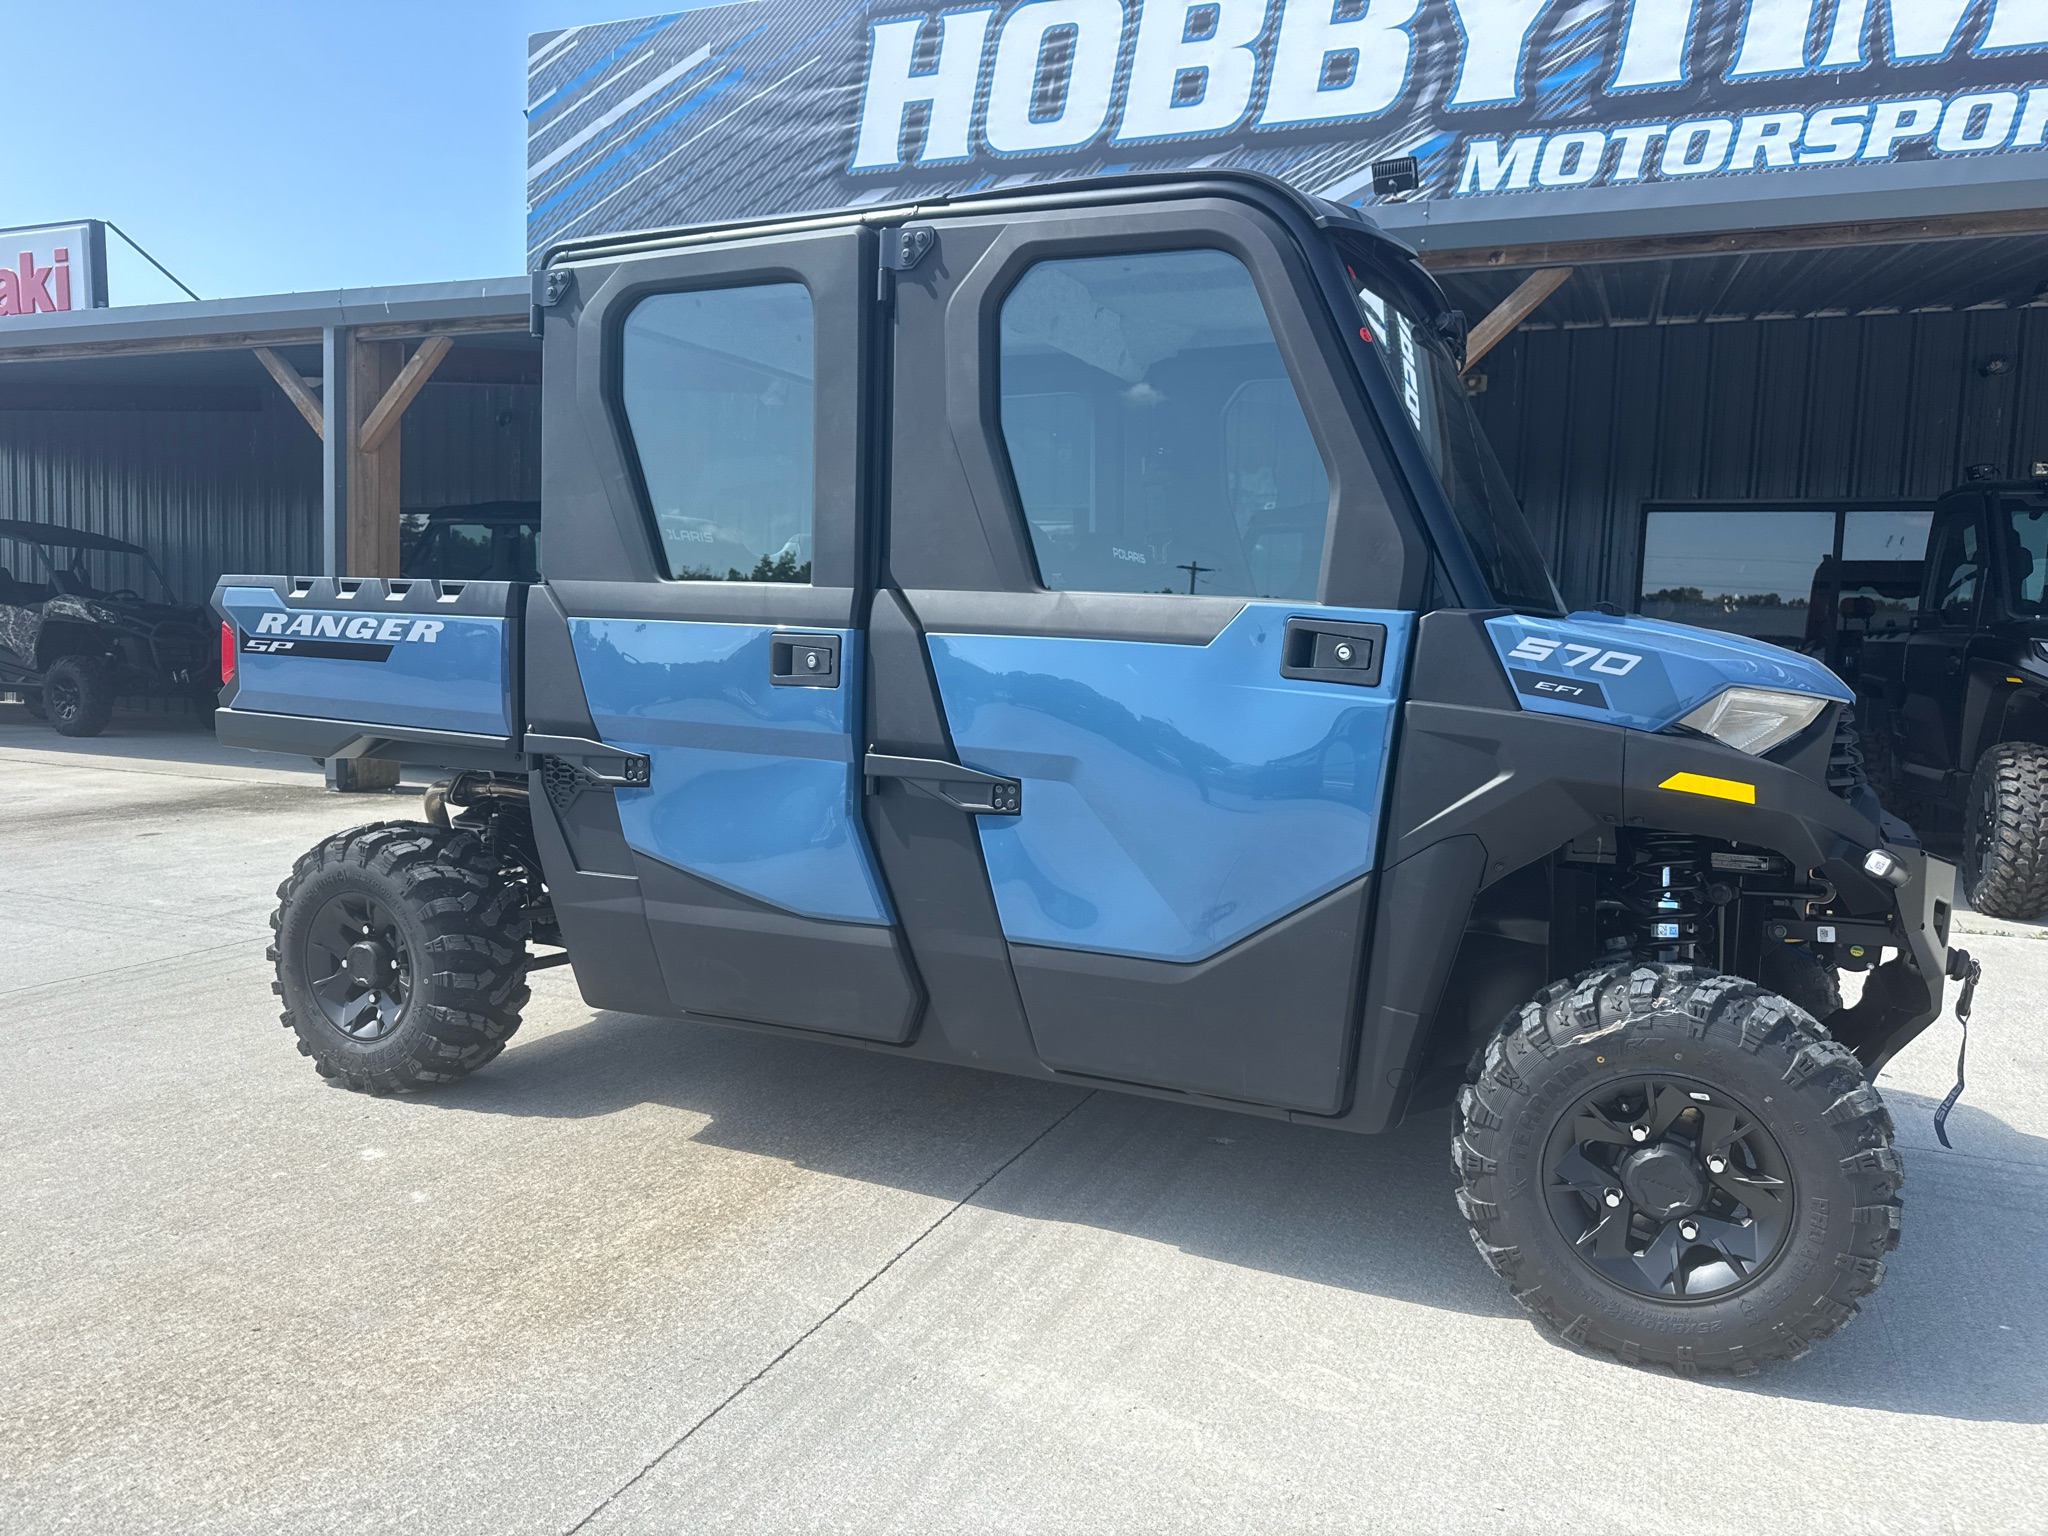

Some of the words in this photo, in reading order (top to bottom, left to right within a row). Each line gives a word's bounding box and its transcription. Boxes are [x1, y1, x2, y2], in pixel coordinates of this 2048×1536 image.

[1112, 546, 1147, 565] POLARIS
[255, 612, 445, 643] RANGER
[244, 640, 295, 653] SP
[1508, 636, 1643, 676] 570
[1534, 681, 1584, 696] EFI
